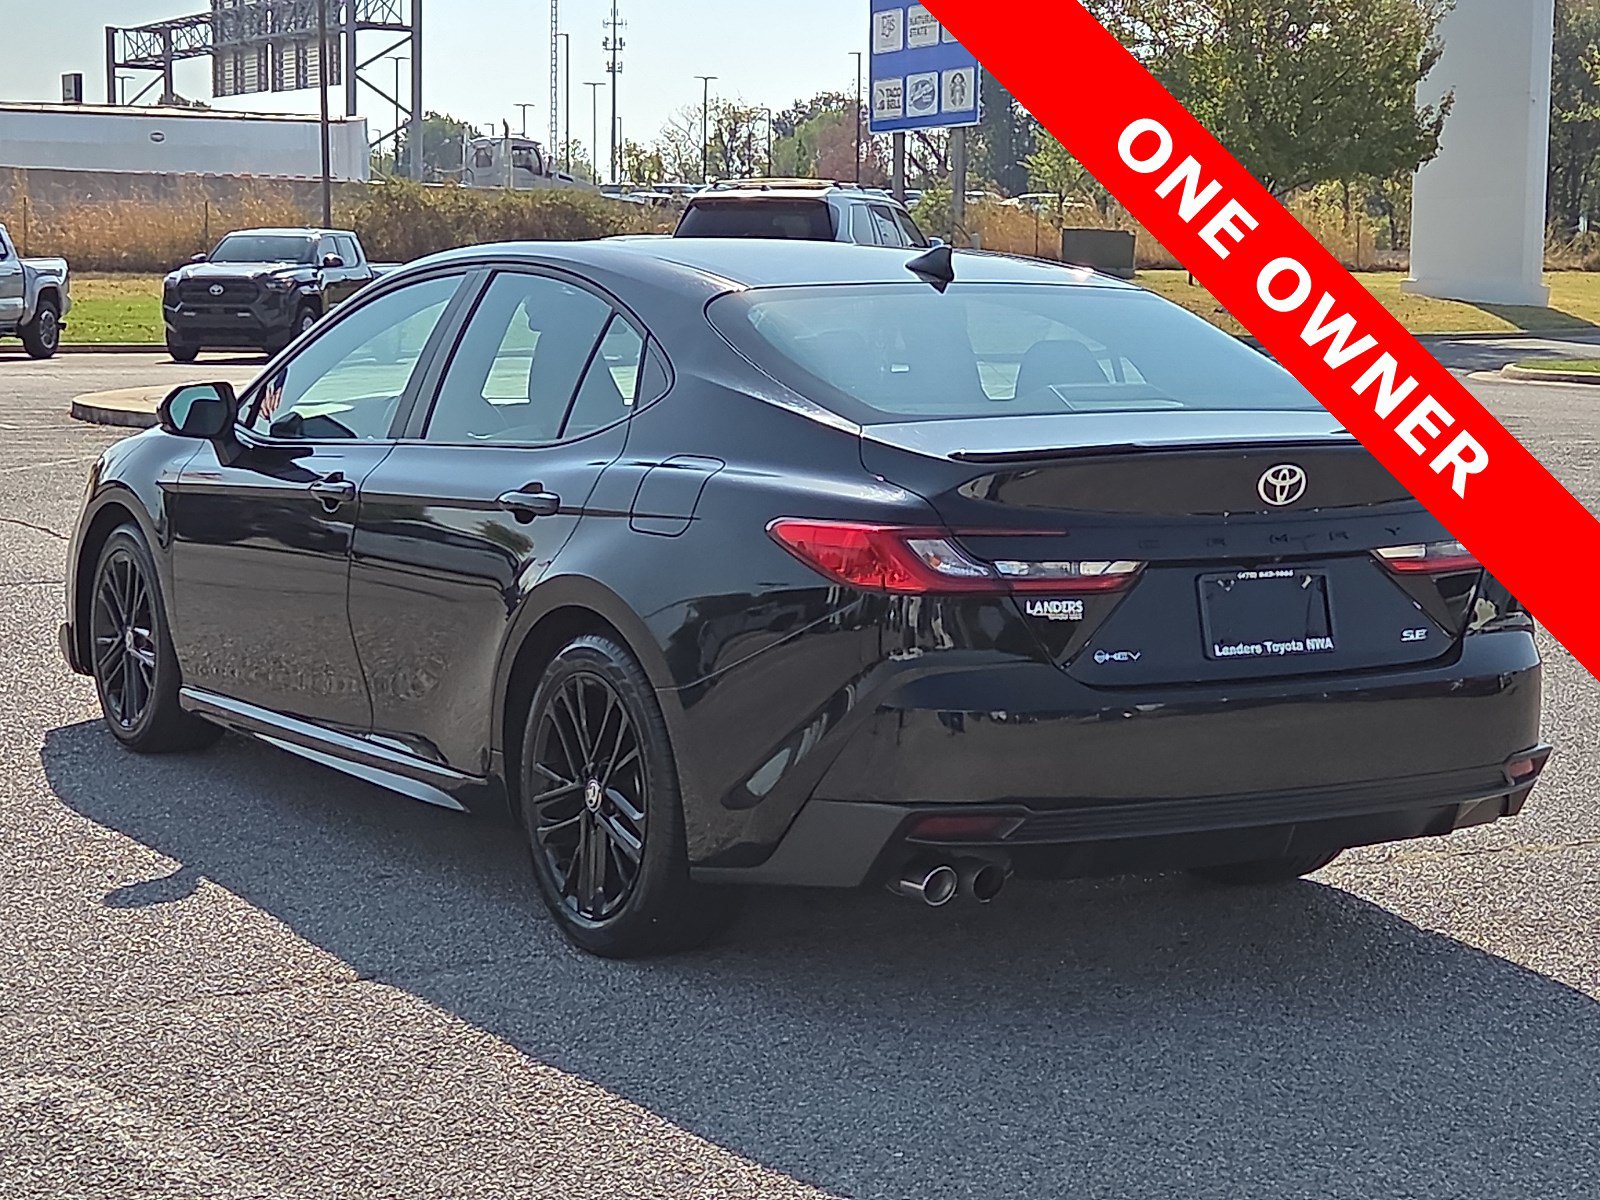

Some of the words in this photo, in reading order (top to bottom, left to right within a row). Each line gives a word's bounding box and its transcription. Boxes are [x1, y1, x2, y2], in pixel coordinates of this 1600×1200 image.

[885, 87, 901, 97] TACO
[886, 98, 901, 110] BELL
[1026, 600, 1084, 614] LANDERS
[1400, 628, 1427, 642] SE
[1214, 643, 1262, 657] Landers
[1263, 640, 1304, 656] Toyota
[1305, 636, 1335, 651] NWA
